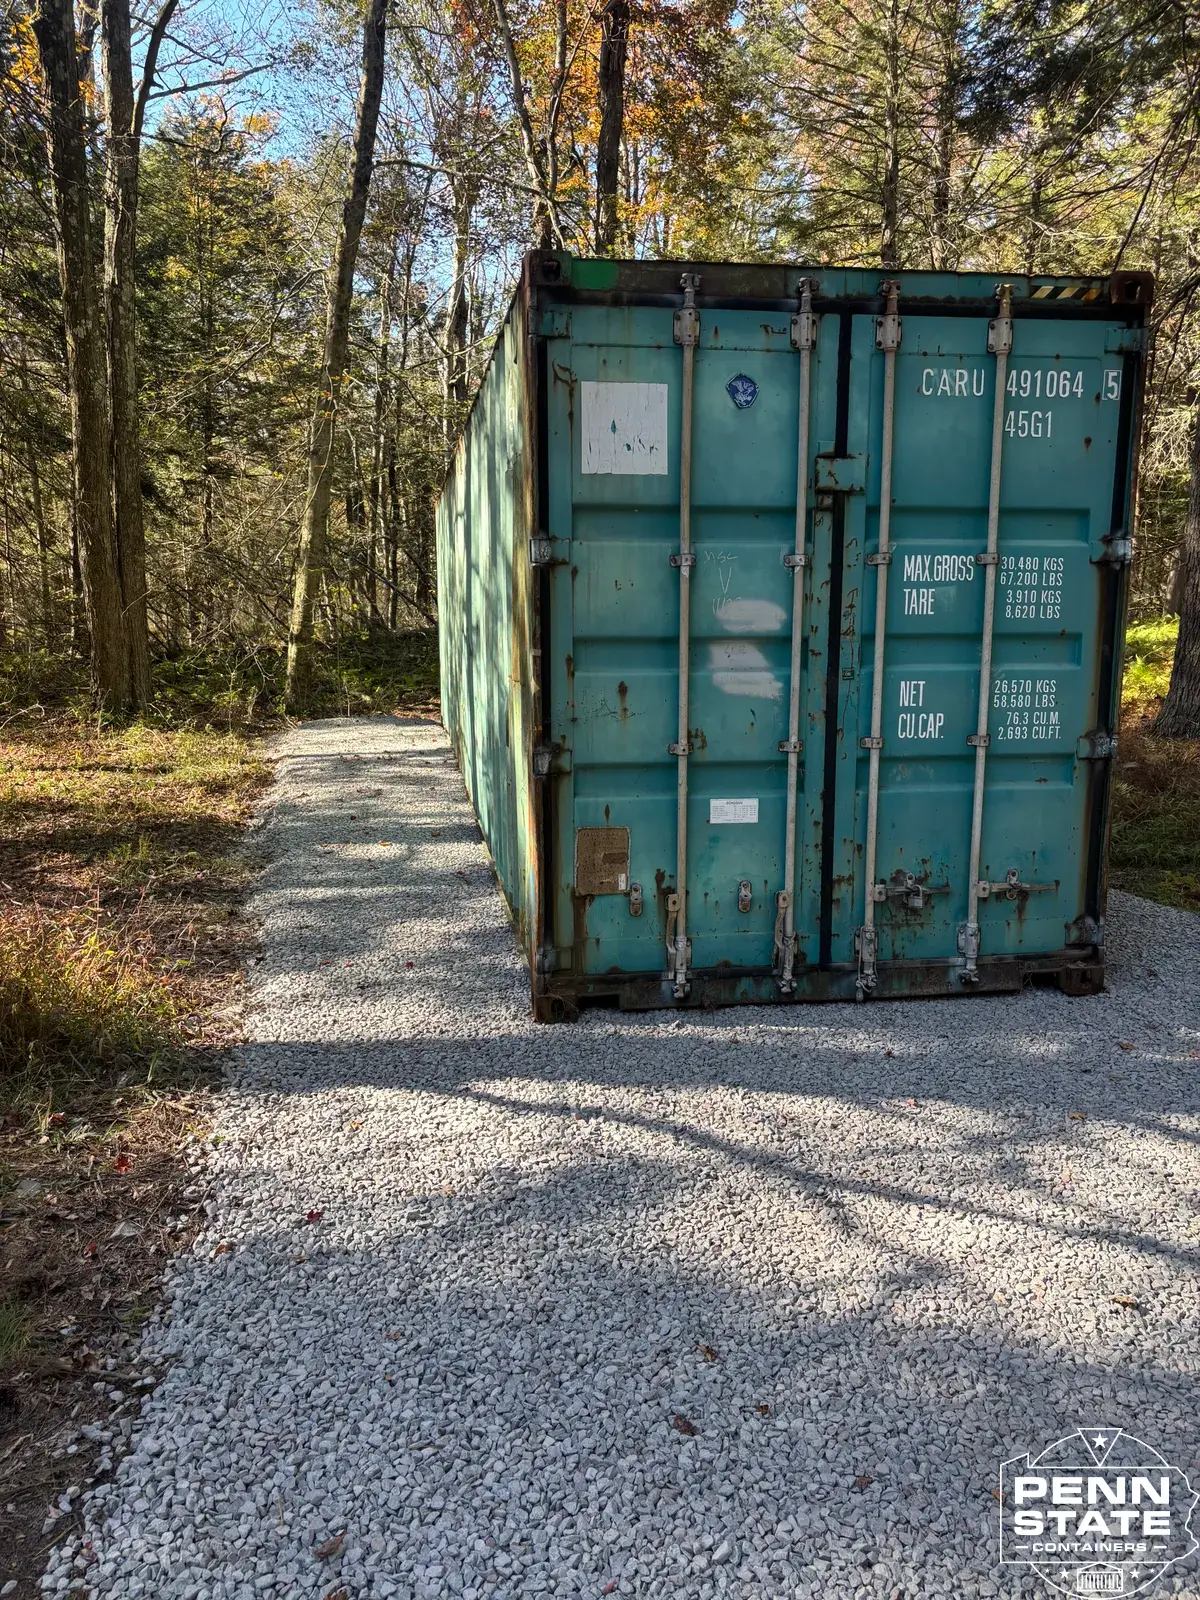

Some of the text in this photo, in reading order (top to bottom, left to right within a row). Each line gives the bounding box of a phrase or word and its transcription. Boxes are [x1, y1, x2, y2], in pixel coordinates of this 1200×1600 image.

[922, 368, 985, 397] CARU
[1006, 369, 1084, 398] 491064
[1004, 410, 1052, 438] 45G1
[903, 554, 975, 582] MAX.GROSS
[1043, 557, 1064, 571] KGS
[1042, 572, 1063, 586] LBS
[903, 588, 936, 615] TARE
[1040, 590, 1062, 604] KGS
[1039, 605, 1061, 619] LBS
[1036, 679, 1057, 693] KGS
[899, 680, 926, 707] NET
[1035, 694, 1056, 708] LBS
[1006, 711, 1061, 725] 76.3 CU.M.
[897, 712, 945, 739] CU.CAP.
[1032, 725, 1062, 740] CU.FT.
